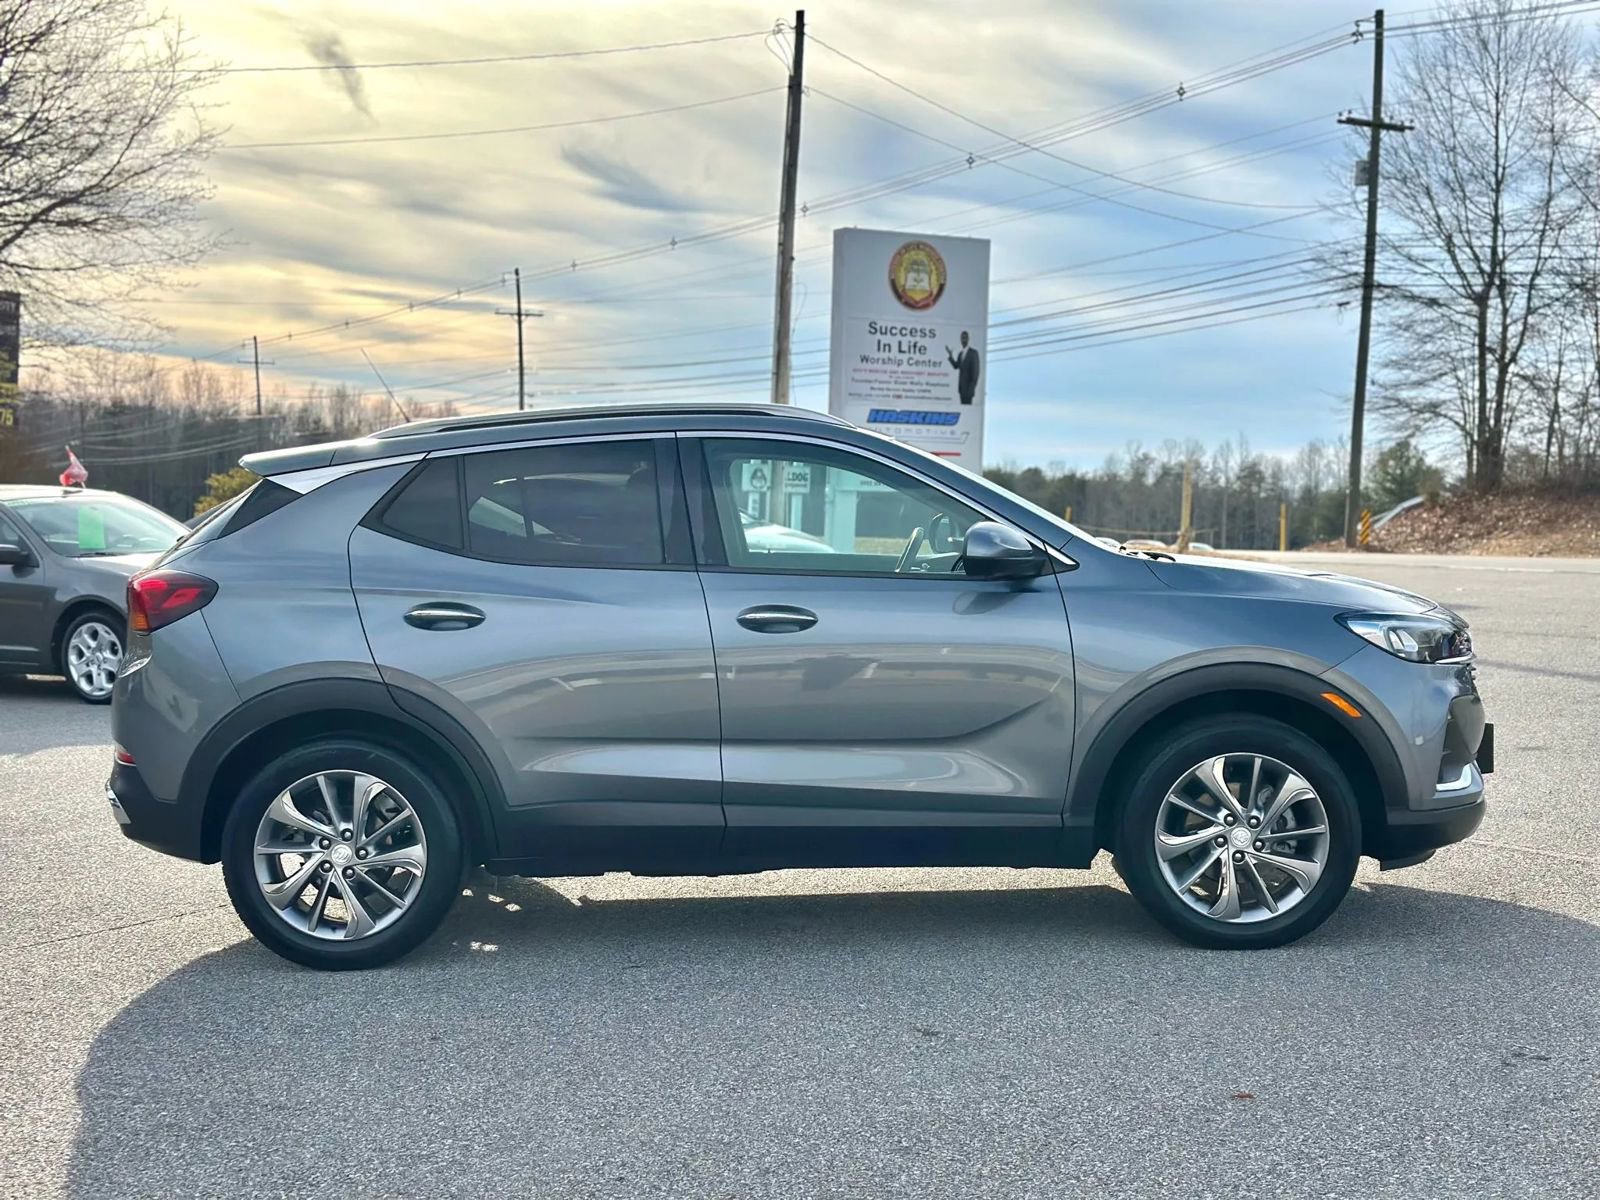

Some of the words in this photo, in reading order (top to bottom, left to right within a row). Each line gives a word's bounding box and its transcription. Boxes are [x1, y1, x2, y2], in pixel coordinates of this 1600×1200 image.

[868, 321, 937, 340] Success
[877, 339, 892, 353] In
[898, 340, 928, 355] Life
[860, 354, 904, 368] Worship
[907, 356, 942, 369] Center
[867, 408, 961, 426] HASKINS
[876, 427, 956, 435] UTOMOTIVE
[786, 471, 809, 482] LDOG
